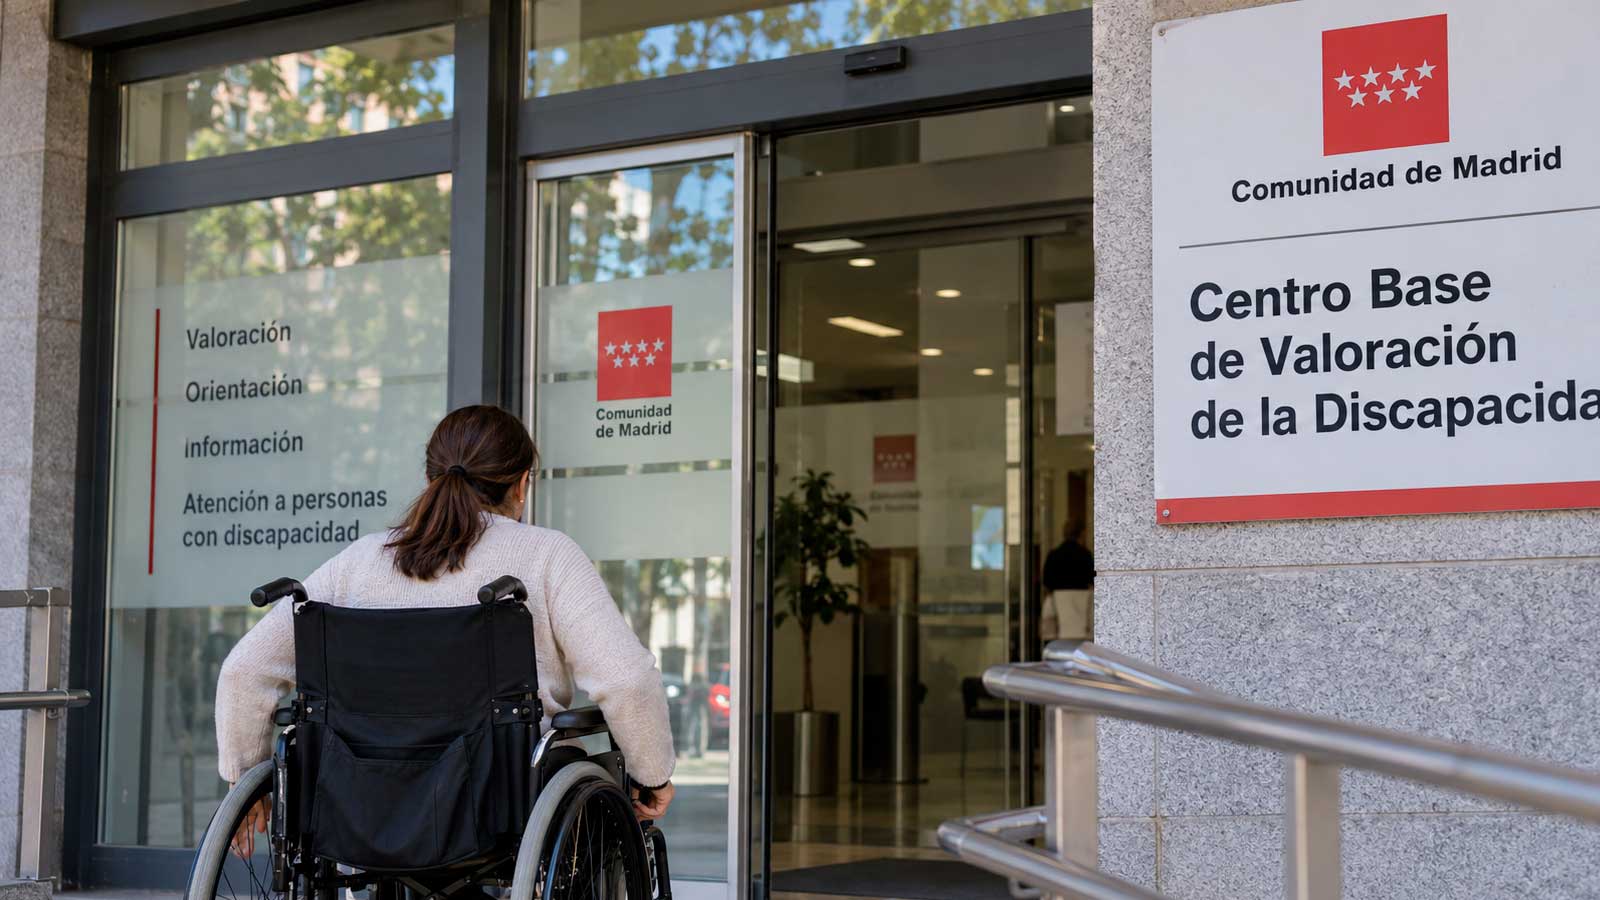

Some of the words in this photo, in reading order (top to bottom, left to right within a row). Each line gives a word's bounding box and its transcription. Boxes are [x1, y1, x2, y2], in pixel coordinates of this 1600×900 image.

[1231, 163, 1394, 203] Comunidad
[1405, 160, 1442, 185] de
[1453, 145, 1562, 180] Madrid
[1190, 278, 1352, 323] Centro
[1371, 267, 1491, 309] Base
[186, 320, 291, 350] Valoración
[1190, 340, 1245, 381] de
[1259, 321, 1517, 376] Valoración
[185, 373, 303, 403] Orientación
[595, 403, 672, 421] Comunidad
[1191, 399, 1244, 440] de
[1261, 396, 1297, 436] la
[1315, 379, 1600, 438] Discapacida
[595, 424, 614, 439] de
[619, 420, 672, 437] Madrid
[182, 489, 269, 515] Atención
[275, 494, 286, 512] a
[292, 490, 388, 516] personas
[182, 530, 218, 548] con
[223, 519, 360, 549] discapacidad
